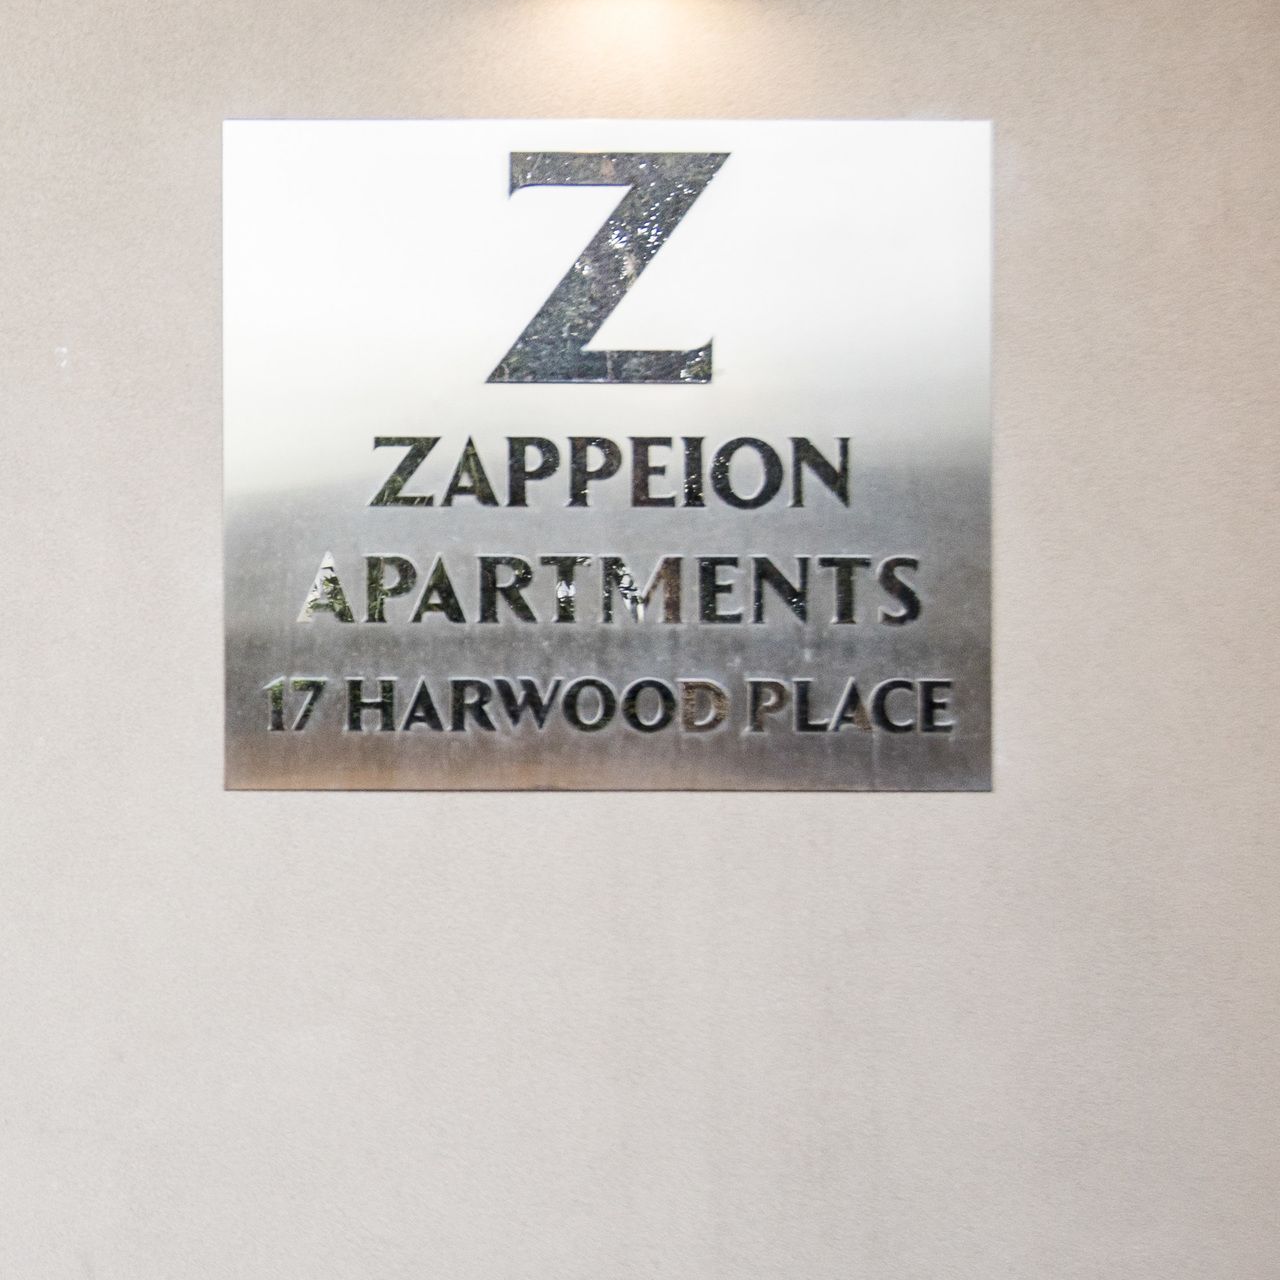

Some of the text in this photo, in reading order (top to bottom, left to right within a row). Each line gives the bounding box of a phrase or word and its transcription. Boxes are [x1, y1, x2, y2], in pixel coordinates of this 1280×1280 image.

[485, 151, 731, 384] Z
[368, 435, 852, 508] ZAPPEION
[296, 552, 922, 625] APARTMENTS
[263, 675, 954, 734] 17 HARWOOD PLACE
